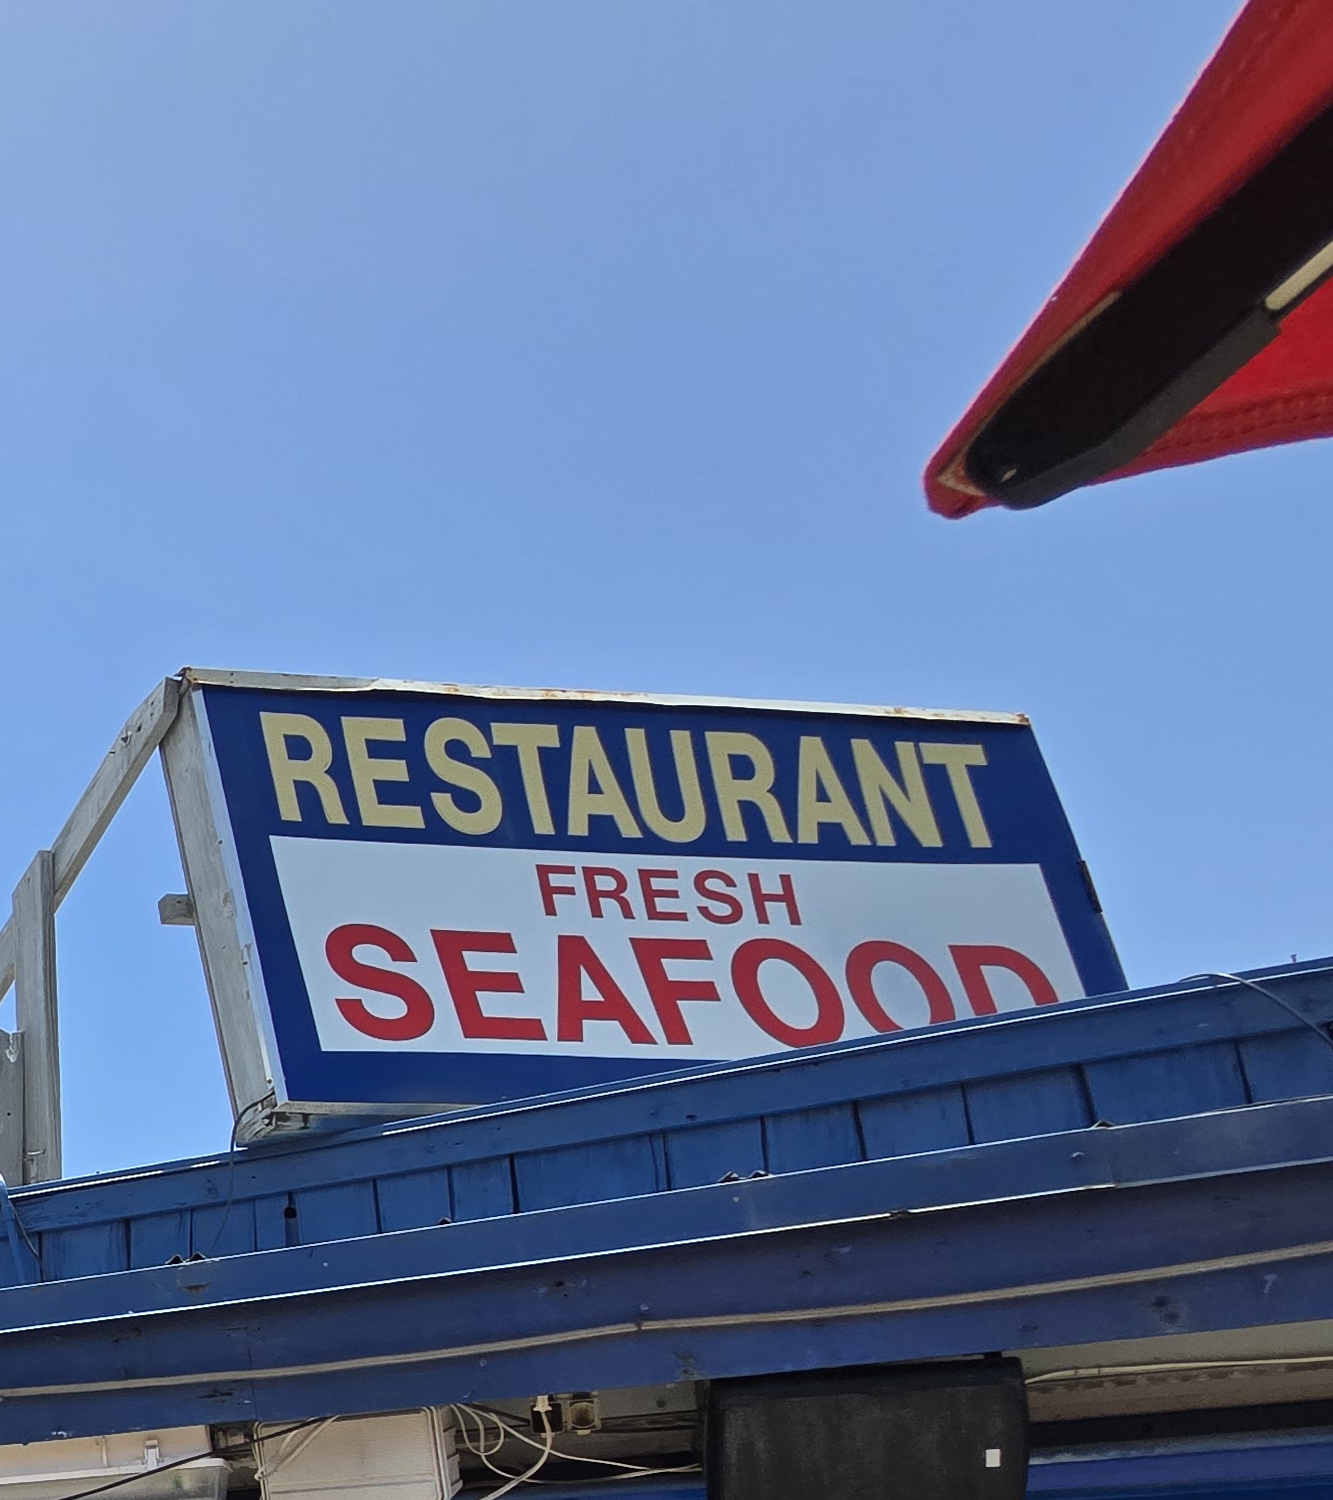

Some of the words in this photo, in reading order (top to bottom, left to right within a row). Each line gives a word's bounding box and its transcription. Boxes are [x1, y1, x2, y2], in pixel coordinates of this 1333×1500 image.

[258, 711, 994, 850] RESTAURANT
[535, 863, 802, 927] FRESH
[324, 922, 1059, 1049] SEAFOOD
